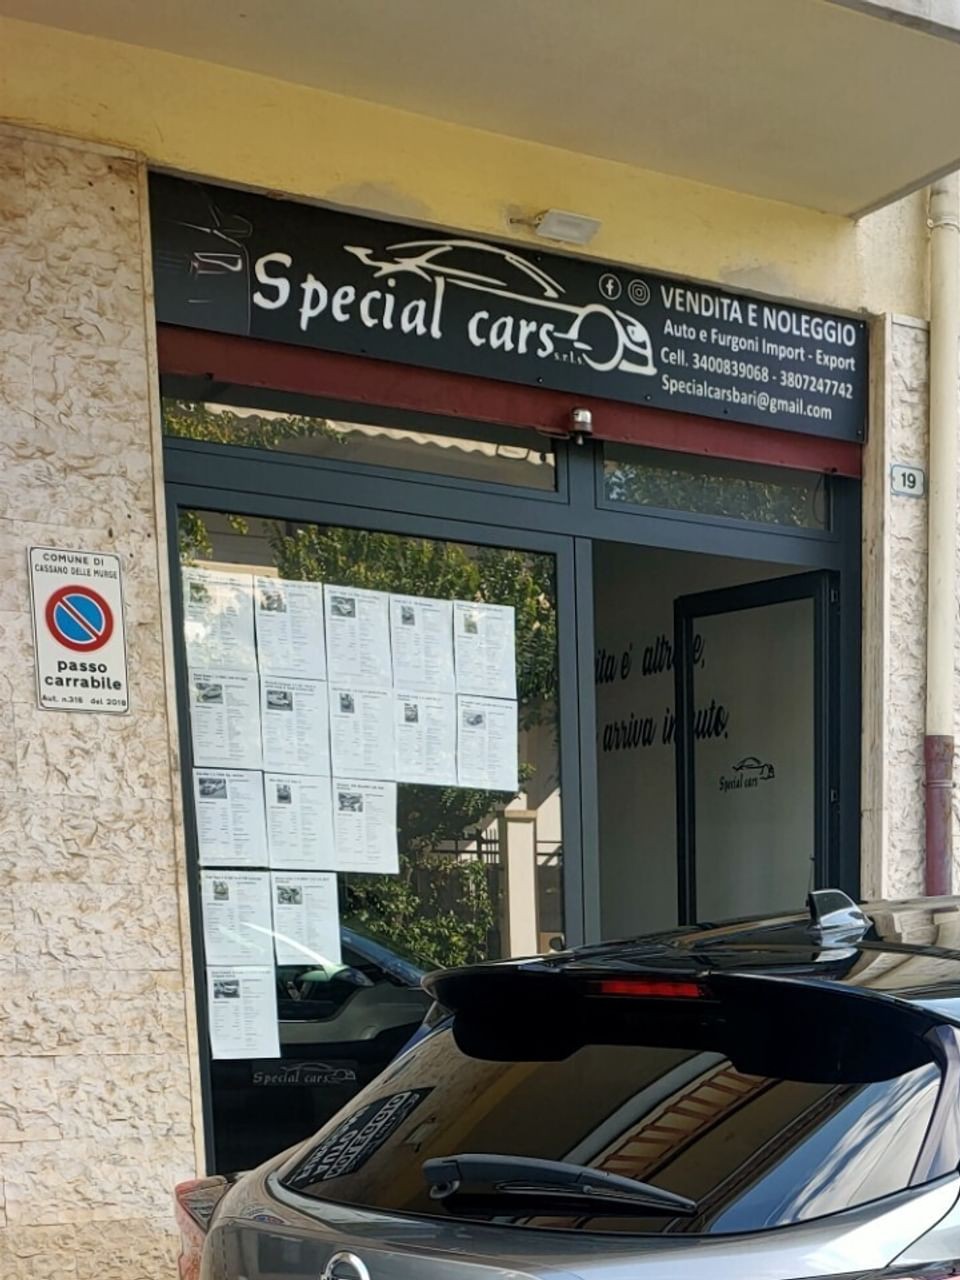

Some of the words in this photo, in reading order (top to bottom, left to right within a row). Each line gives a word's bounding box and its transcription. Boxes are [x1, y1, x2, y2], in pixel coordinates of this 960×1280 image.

[253, 252, 445, 340] Special
[467, 310, 555, 359] cars
[661, 285, 743, 325] VENDITA
[748, 303, 758, 327] E
[763, 306, 856, 347] NOLEGGIO
[664, 319, 696, 341] Auto
[699, 328, 708, 342] e
[711, 329, 759, 352] Furgoni
[762, 338, 805, 362] Import
[816, 349, 856, 371] Export
[661, 347, 688, 367] Cell.
[692, 353, 769, 382] 3400839068
[780, 371, 853, 399] 3807247742
[662, 374, 832, 420] Specialcarsbari@gmail.com
[901, 472, 917, 489] 19
[35, 563, 68, 576] CASSANO
[71, 566, 91, 577] DELLE
[93, 569, 118, 579] MURGE
[43, 553, 89, 565] COMUNE
[93, 556, 104, 566] DI
[45, 676, 122, 691] carrabile
[57, 660, 107, 674] passo
[595, 649, 619, 685] ita
[603, 713, 657, 752] arriva
[694, 699, 730, 739] uto.
[253, 1071, 299, 1085] Special
[304, 1074, 329, 1084] cars
